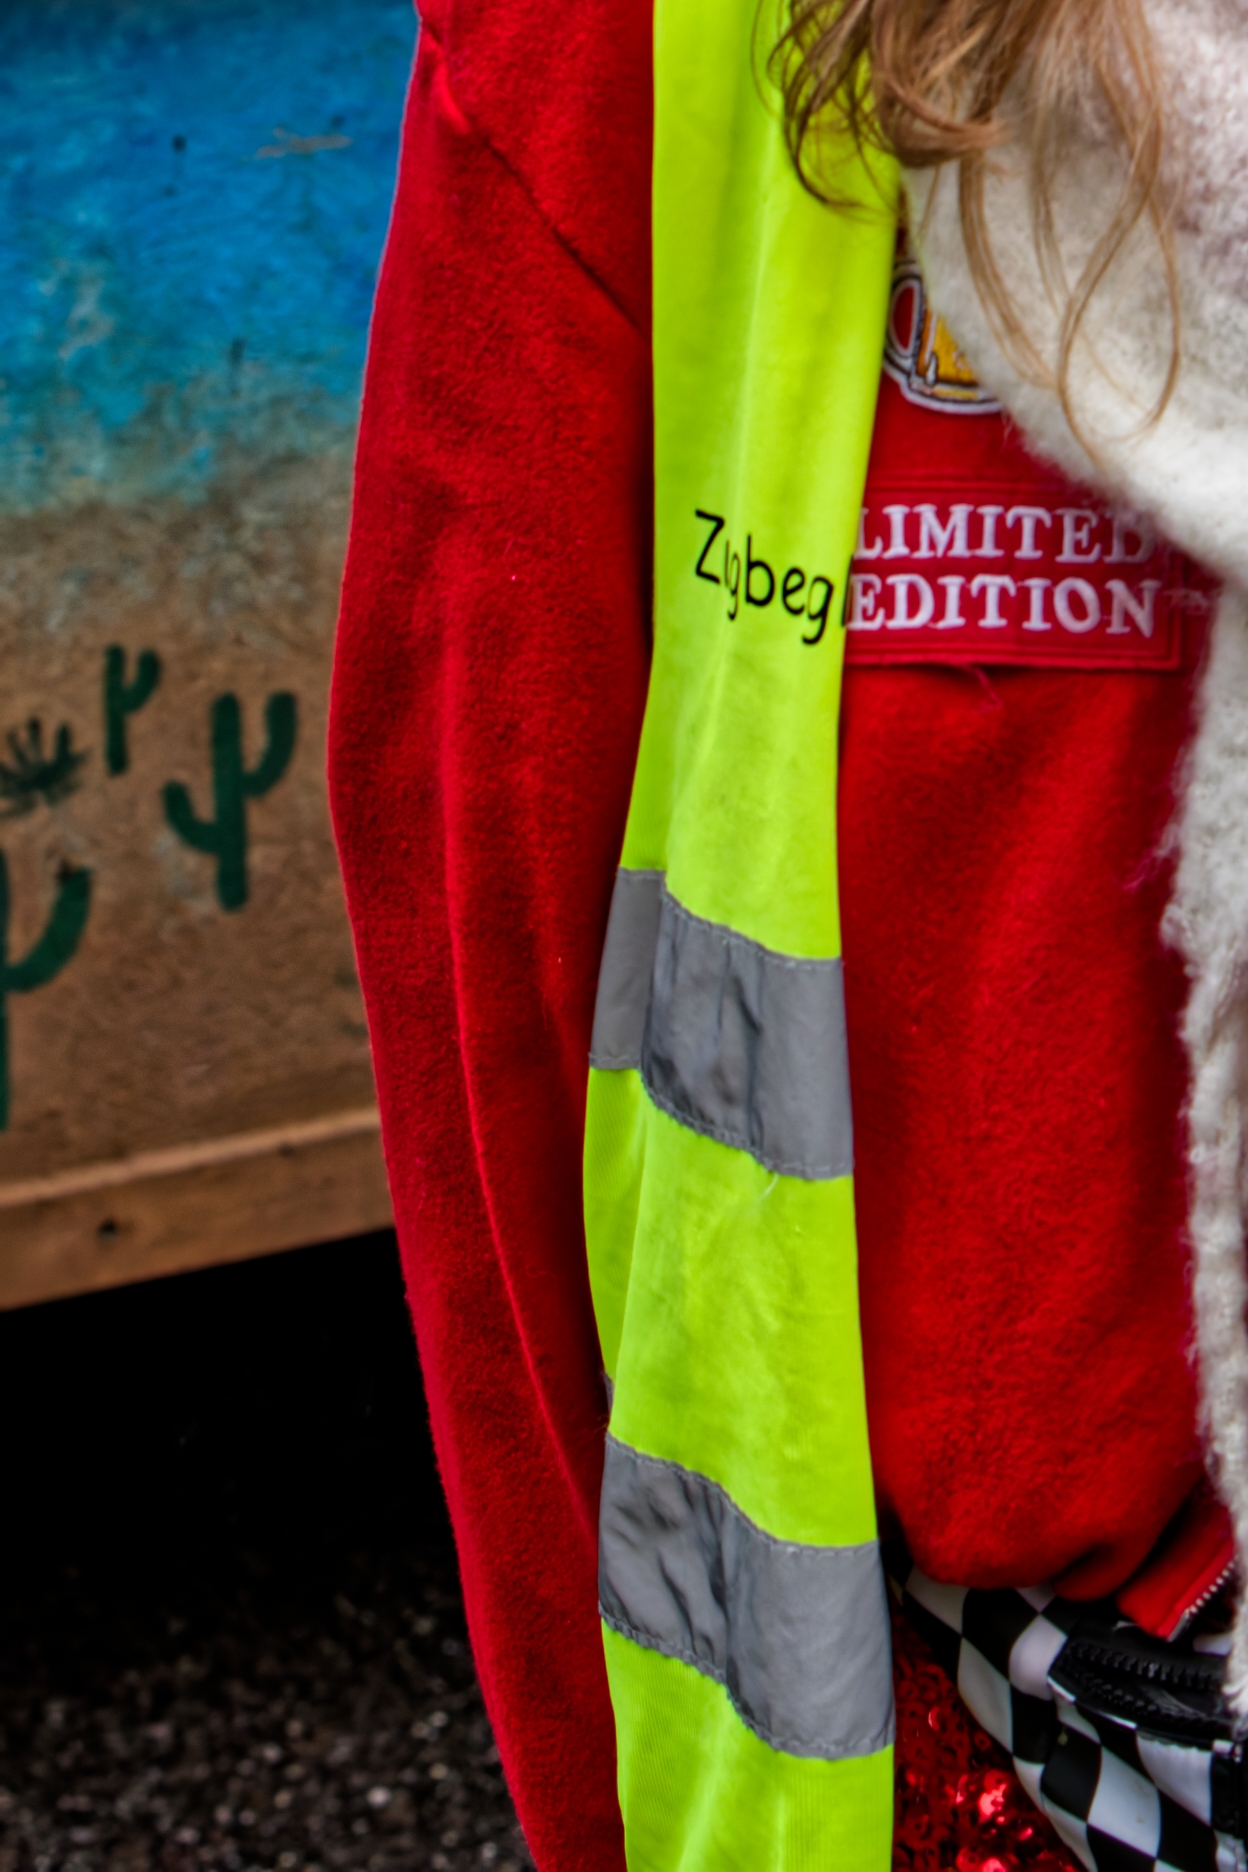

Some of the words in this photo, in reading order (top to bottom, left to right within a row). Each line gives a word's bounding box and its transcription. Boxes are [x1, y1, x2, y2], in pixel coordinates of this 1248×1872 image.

[852, 503, 1157, 565] LIMITED
[695, 509, 853, 645] Zigbeg
[847, 574, 1162, 638] EDITION
